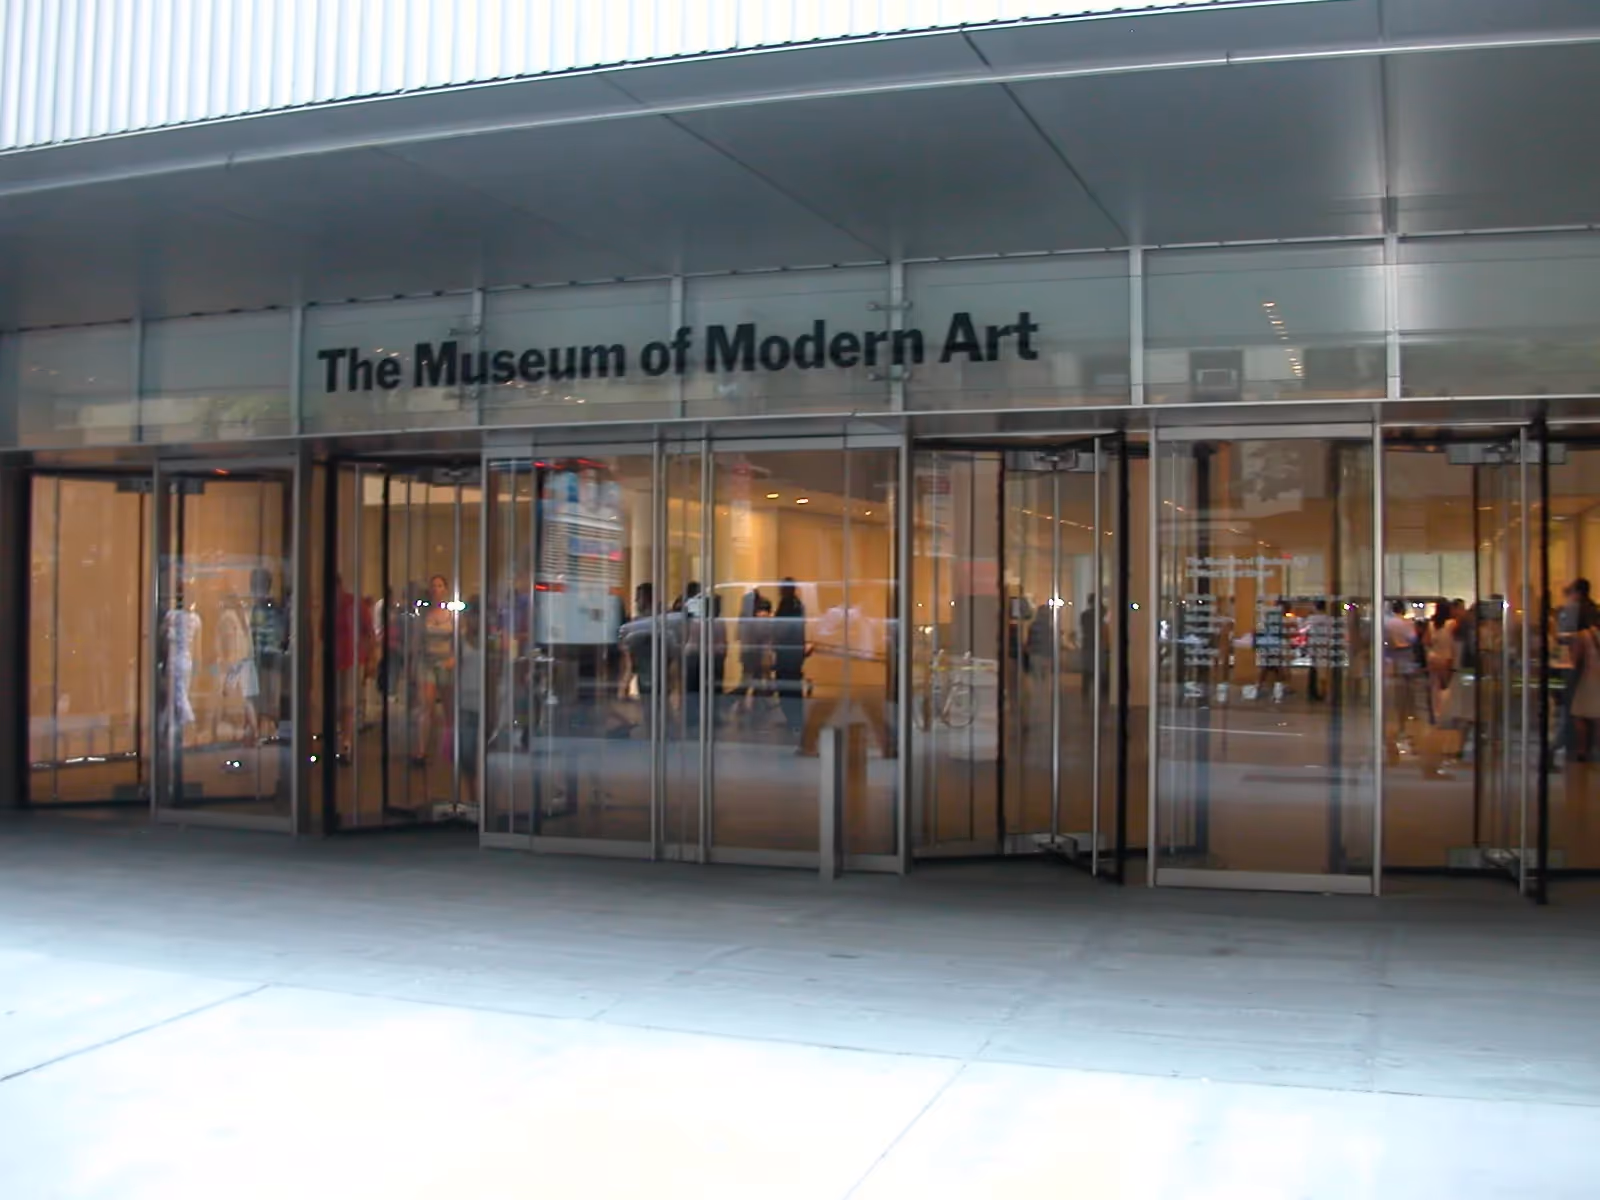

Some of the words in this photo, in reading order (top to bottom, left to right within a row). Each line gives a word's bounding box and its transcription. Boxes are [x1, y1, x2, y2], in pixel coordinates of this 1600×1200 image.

[318, 347, 401, 393] The
[413, 341, 626, 388] Museum
[640, 326, 692, 377] of
[704, 320, 924, 373] Modern
[938, 312, 1039, 363] Art
